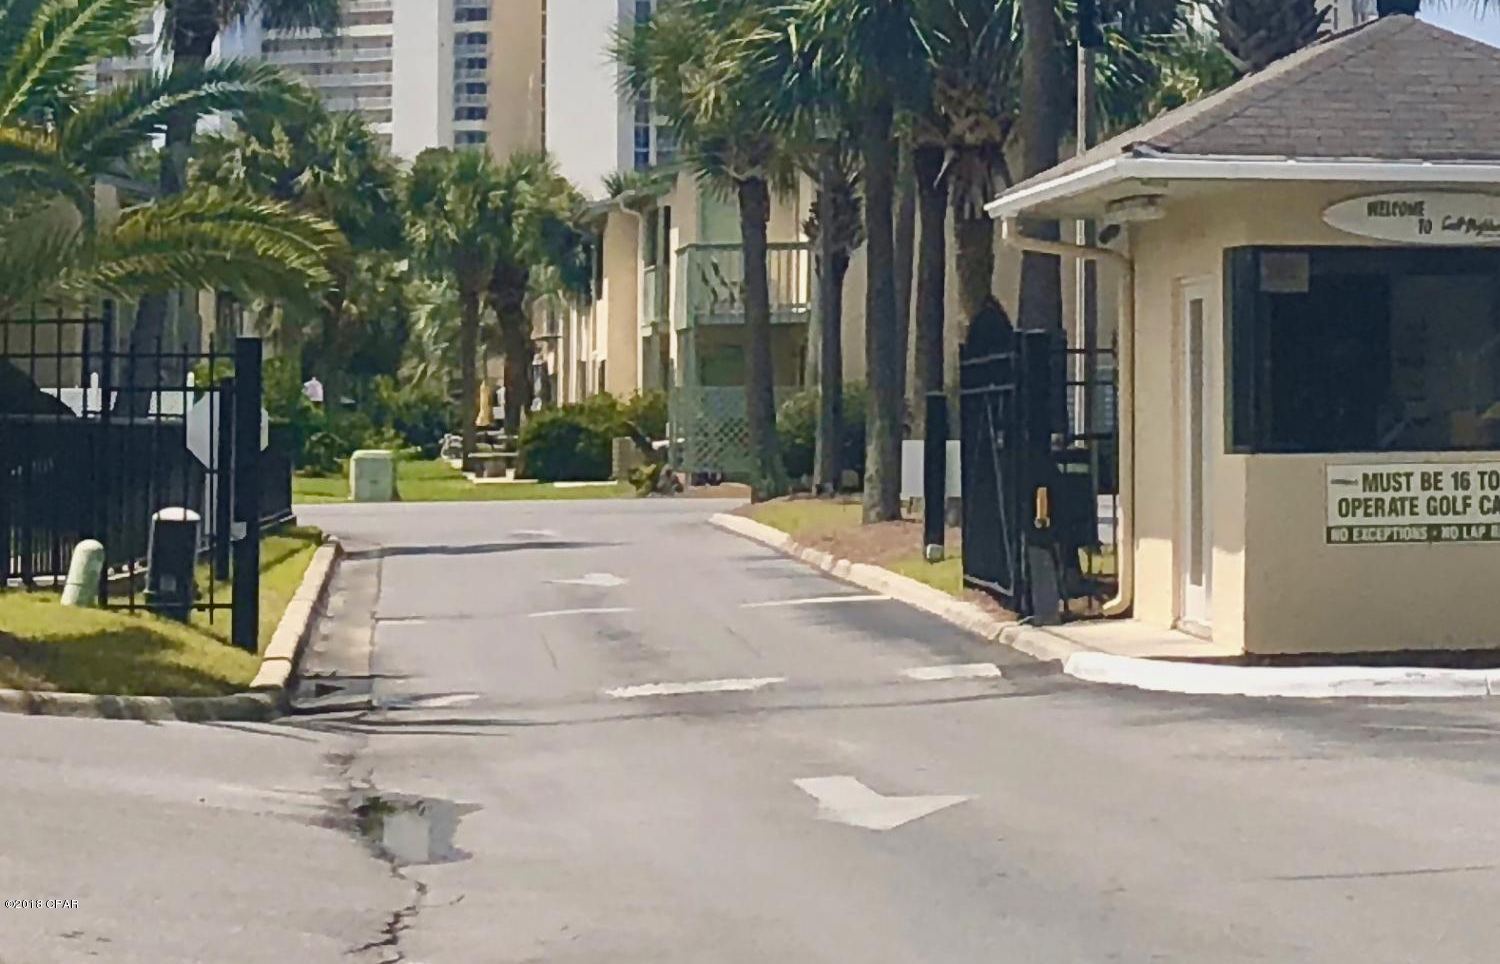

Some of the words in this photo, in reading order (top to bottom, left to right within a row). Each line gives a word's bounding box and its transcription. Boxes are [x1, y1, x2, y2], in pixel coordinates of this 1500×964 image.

[1366, 200, 1425, 217] WELCOME
[1418, 218, 1433, 234] TO
[1362, 472, 1414, 493] MUST
[1420, 471, 1444, 491] BE
[1450, 471, 1471, 491] 16
[1477, 470, 1500, 491] TO
[1337, 496, 1420, 518] OPERATE
[1426, 495, 1472, 516] GOLF
[1330, 527, 1349, 541] NO
[1352, 525, 1428, 541] EXCEPTIONS
[1441, 525, 1460, 540] NO
[1463, 525, 1486, 539] LAP
